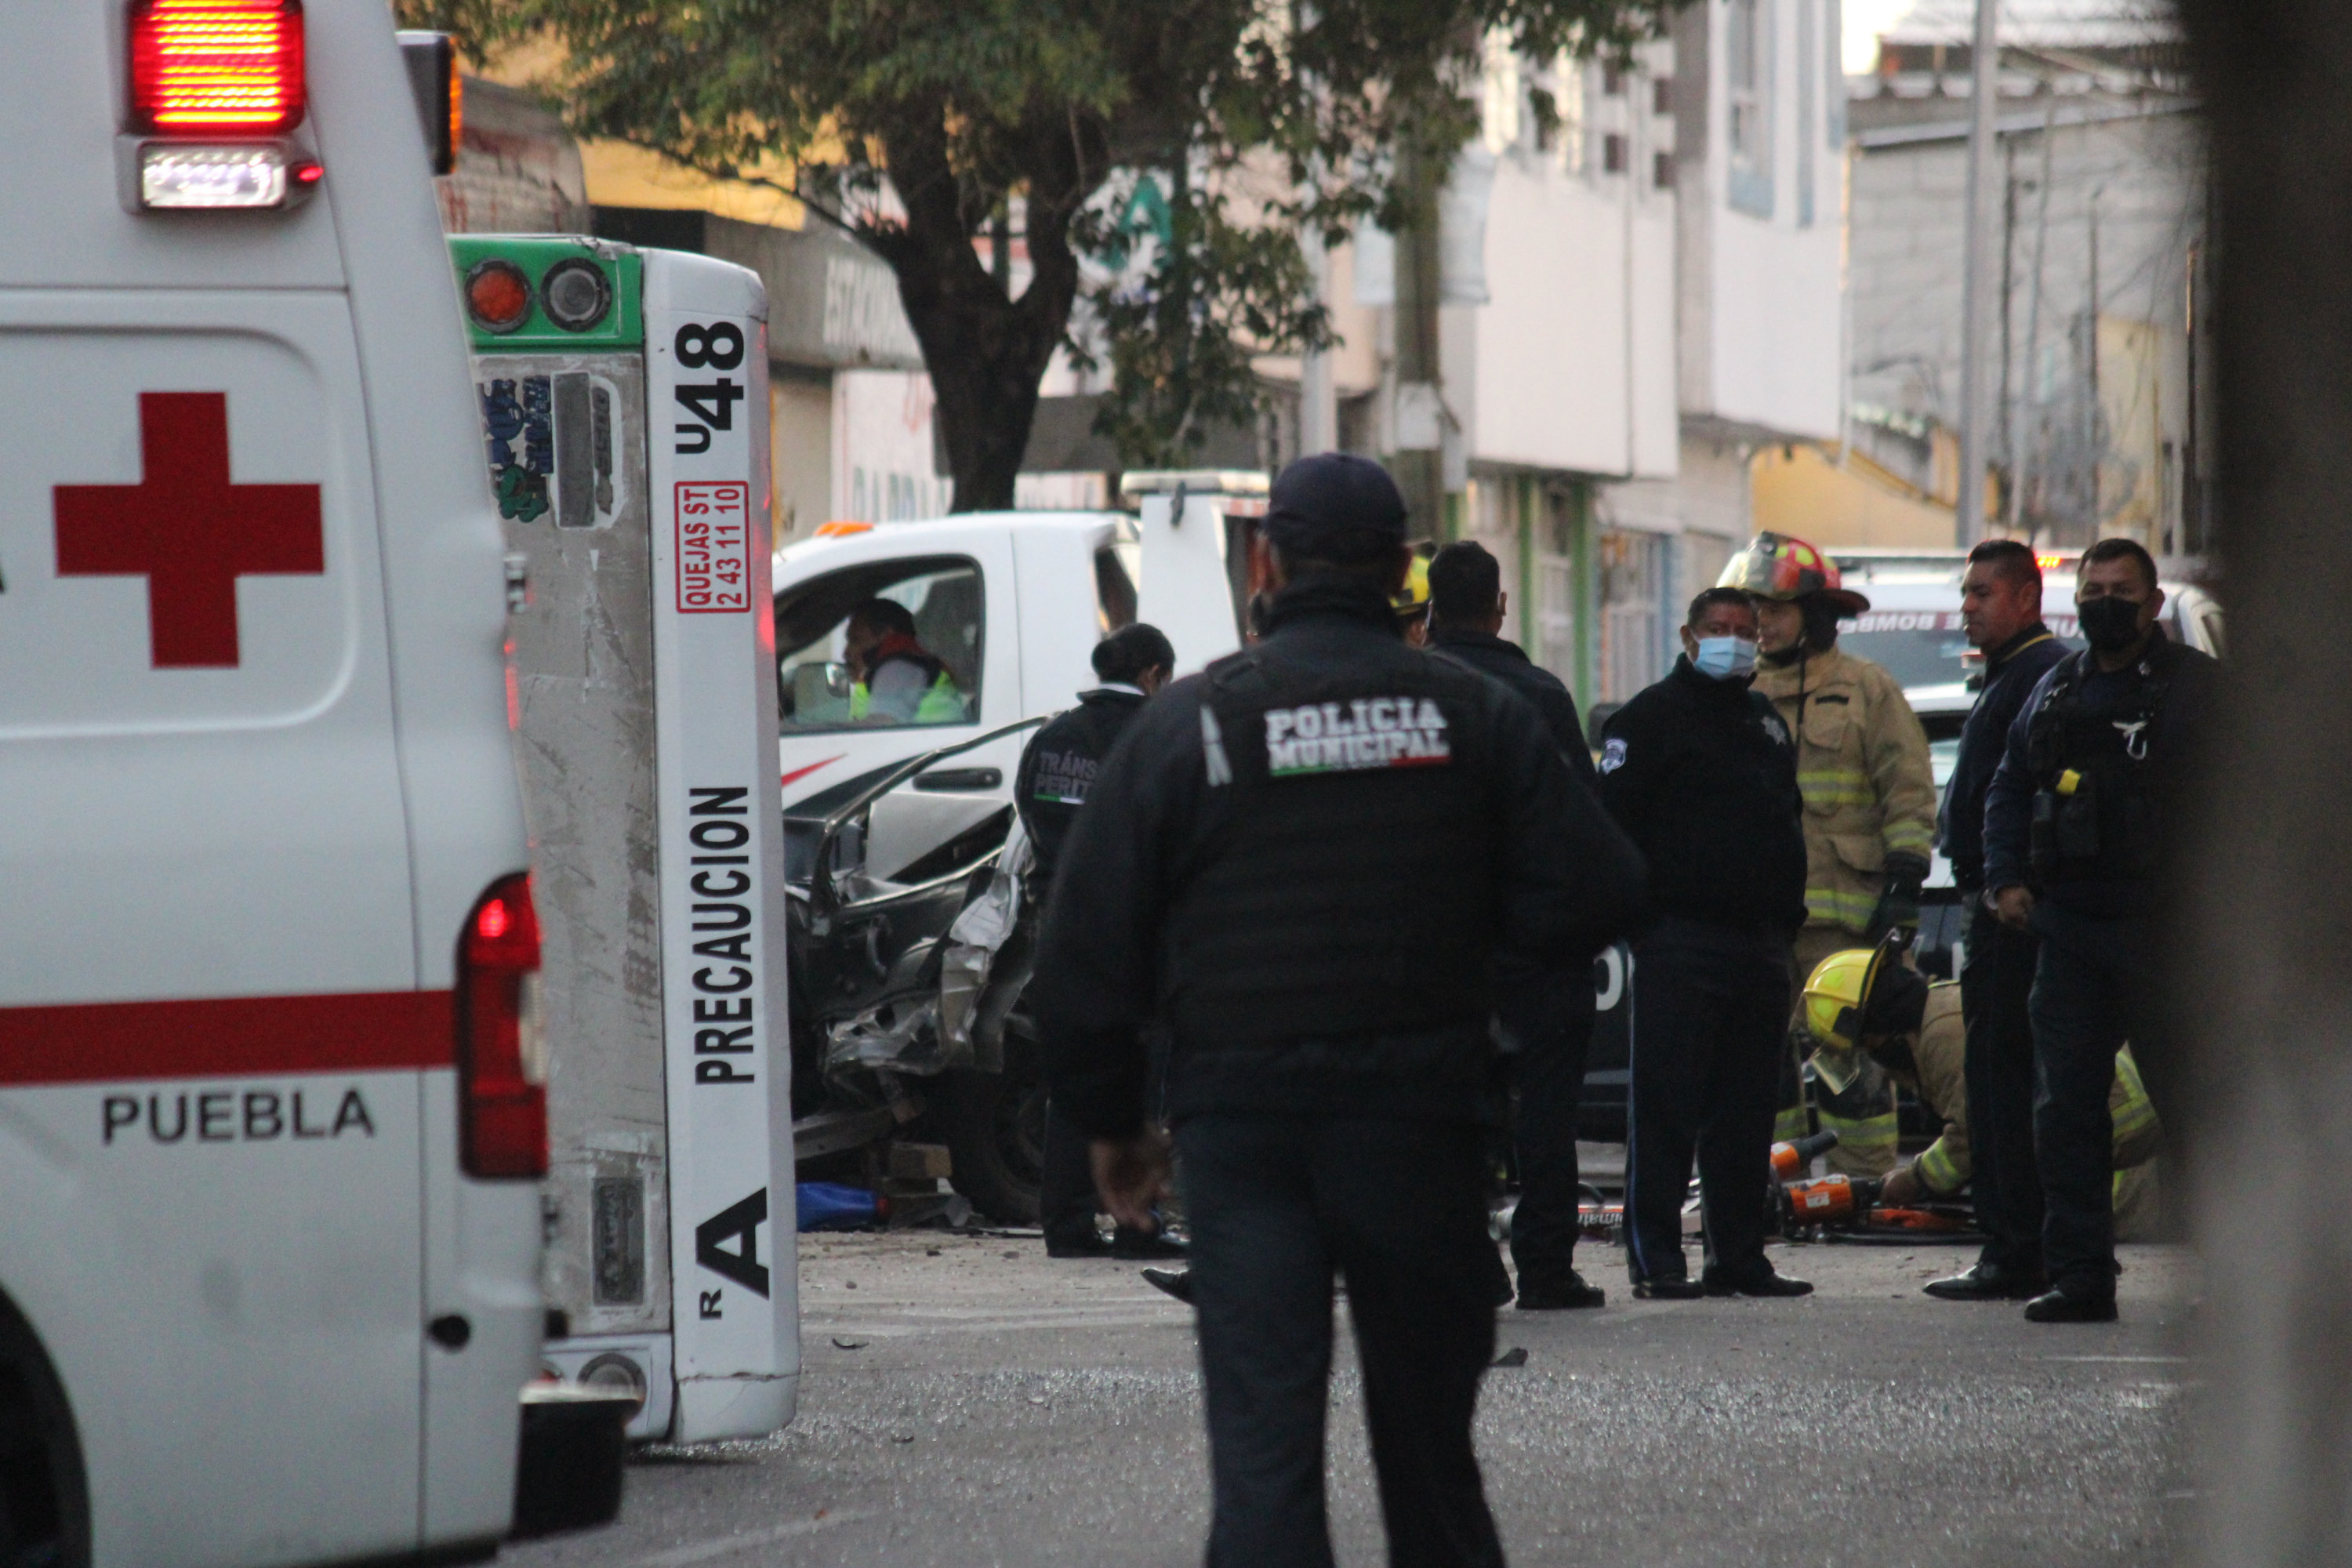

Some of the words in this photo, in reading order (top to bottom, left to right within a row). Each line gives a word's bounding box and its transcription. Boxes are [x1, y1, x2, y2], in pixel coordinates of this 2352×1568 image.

[684, 488, 710, 516] ST
[714, 488, 740, 514] 10
[717, 525, 740, 549] 11
[684, 521, 710, 606] QUEJAS
[716, 557, 742, 585] 43
[717, 592, 742, 606] 2
[1264, 696, 1448, 742] POLICIA
[1268, 729, 1450, 771] MUNICIPAL
[1040, 750, 1098, 780] TRÁNS
[1034, 773, 1091, 798] PERIT
[689, 786, 755, 1086] PRECAUCION
[101, 1087, 376, 1147] PUEBLA
